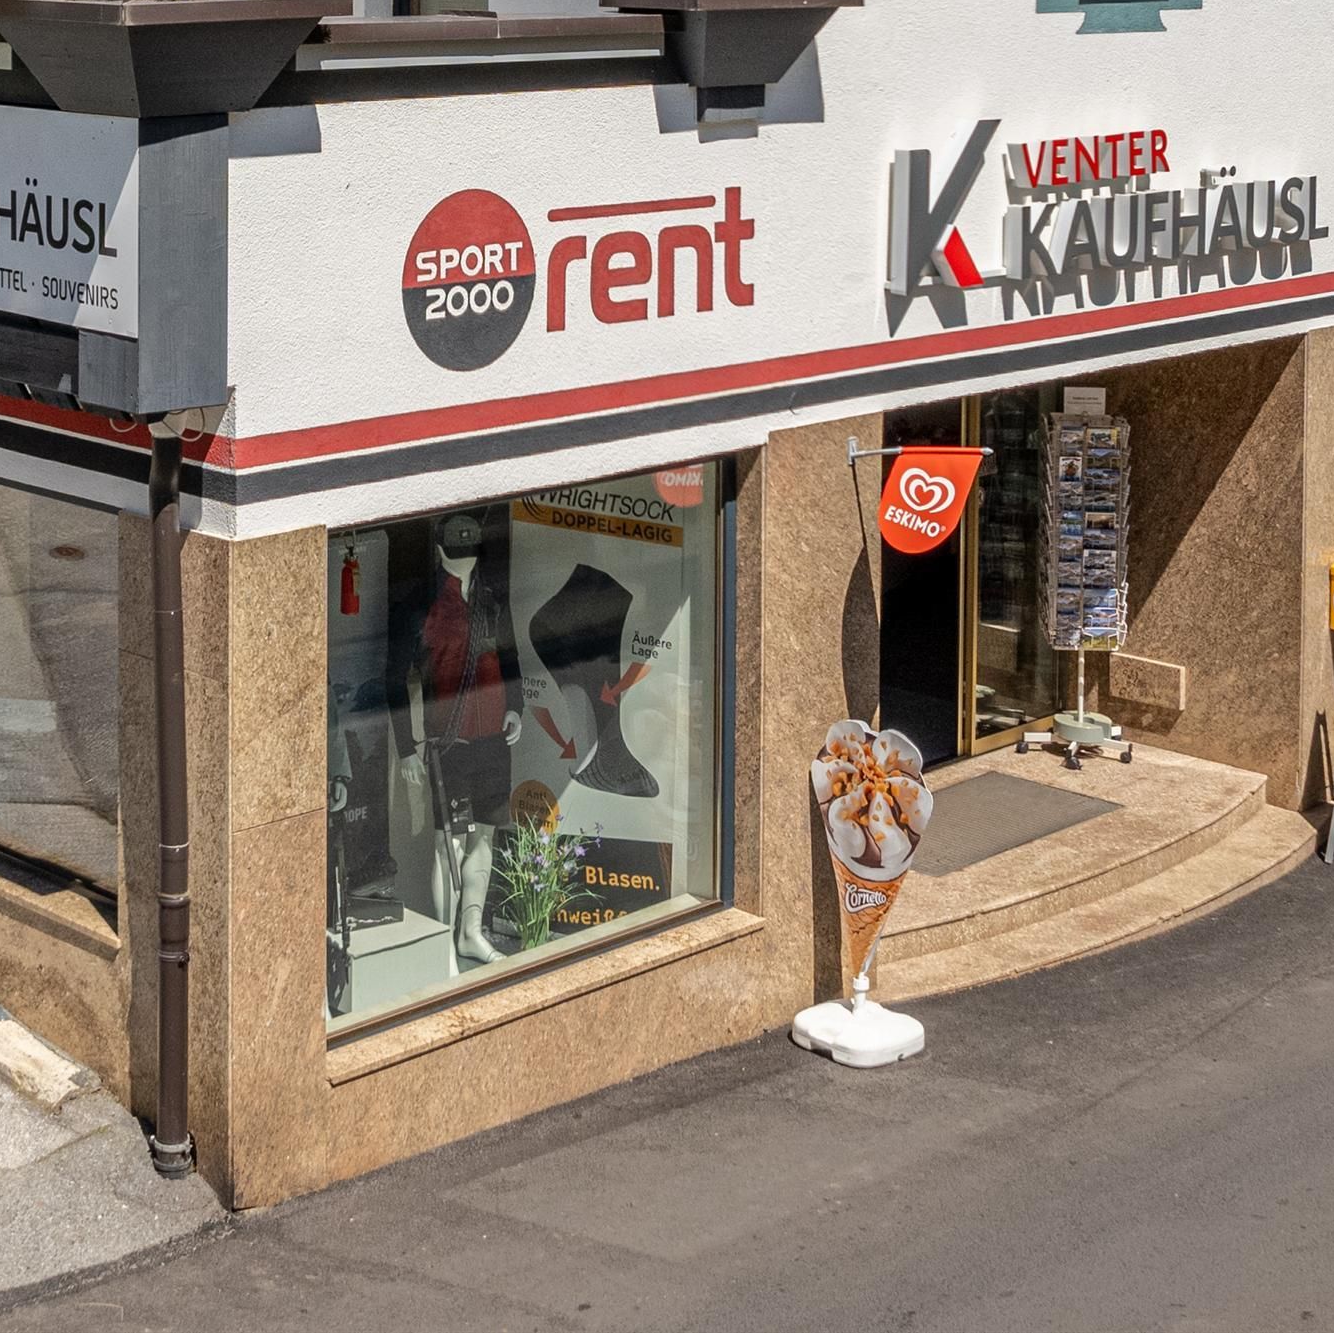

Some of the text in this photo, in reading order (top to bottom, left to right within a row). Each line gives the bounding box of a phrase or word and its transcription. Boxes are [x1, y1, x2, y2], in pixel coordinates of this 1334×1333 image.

[1021, 129, 1170, 189] VENTER
[1019, 166, 1329, 281] KAUFHÄUSL
[415, 241, 524, 283] SPORT
[547, 186, 755, 333] rent
[42, 275, 119, 310] SOUVENIRS
[425, 279, 515, 321] 2000
[538, 488, 675, 522] WRIGHTSOCK
[551, 511, 674, 543] DOPPEL-LAGIG
[631, 643, 659, 660] Lage
[632, 631, 672, 650] Äußere
[585, 865, 661, 892] Blasen.
[845, 882, 887, 913] Cornetto
